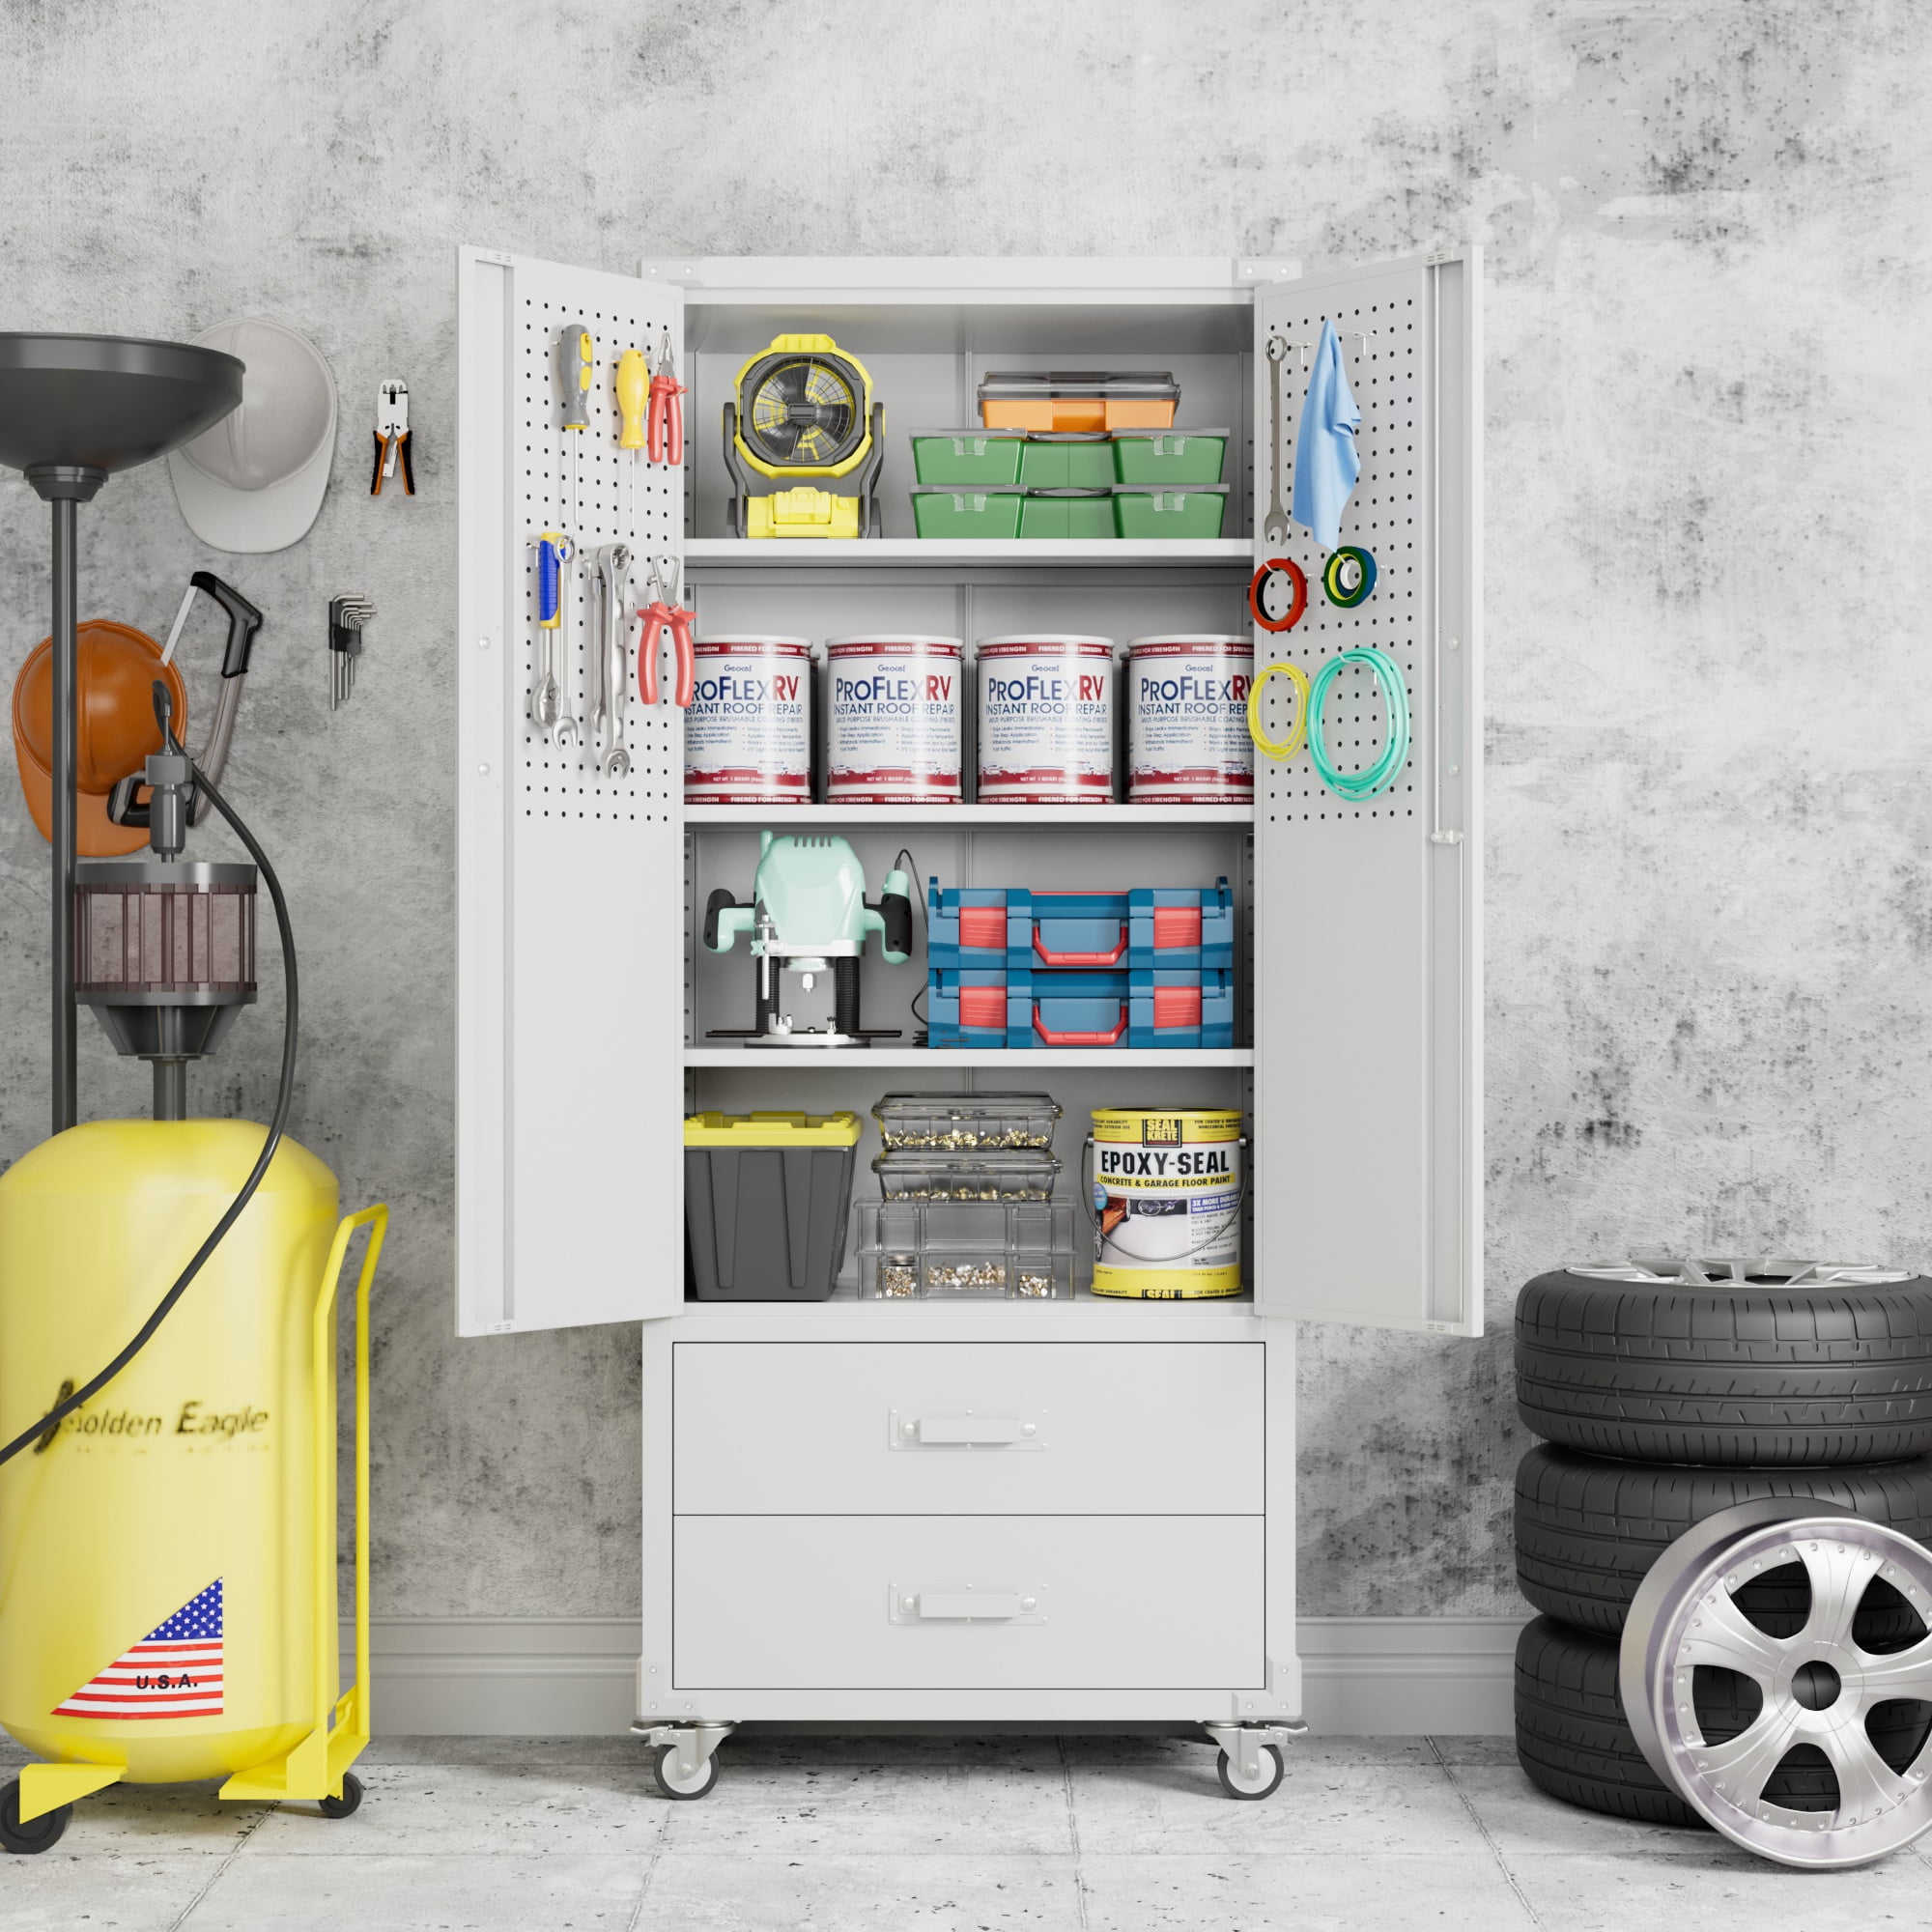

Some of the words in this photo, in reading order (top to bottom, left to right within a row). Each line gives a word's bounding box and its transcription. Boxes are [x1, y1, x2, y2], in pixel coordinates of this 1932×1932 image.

[724, 664, 752, 672] Geocel
[877, 664, 905, 672] Geocel
[1032, 664, 1059, 672] Geocel
[1184, 664, 1213, 672] Geocel
[684, 703, 721, 715] NSTANT
[723, 702, 765, 714] ROOF
[769, 703, 803, 715] REPAIR
[834, 703, 873, 715] INSTANT
[877, 702, 920, 714] ROOF
[923, 703, 954, 715] REPAIR
[985, 703, 1028, 715] INSTANT
[1031, 702, 1073, 714] ROOF
[1076, 703, 1107, 715] REPAIR
[1138, 703, 1180, 715] INSTANT
[1184, 702, 1227, 714] ROOF
[1229, 703, 1247, 715] REP
[1147, 1120, 1178, 1130] SEAL
[1147, 1130, 1179, 1142] KRETE
[1101, 1150, 1230, 1175] EPOXY-SEAL
[1100, 1177, 1132, 1187] CONCRETE
[1144, 1179, 1180, 1187] GARAGE
[1182, 1176, 1208, 1186] FLOOR
[1210, 1175, 1231, 1184] PAINT
[1202, 1197, 1219, 1206] MORE
[176, 1400, 270, 1441] Eagle
[135, 1673, 198, 1690] U.S.A.
